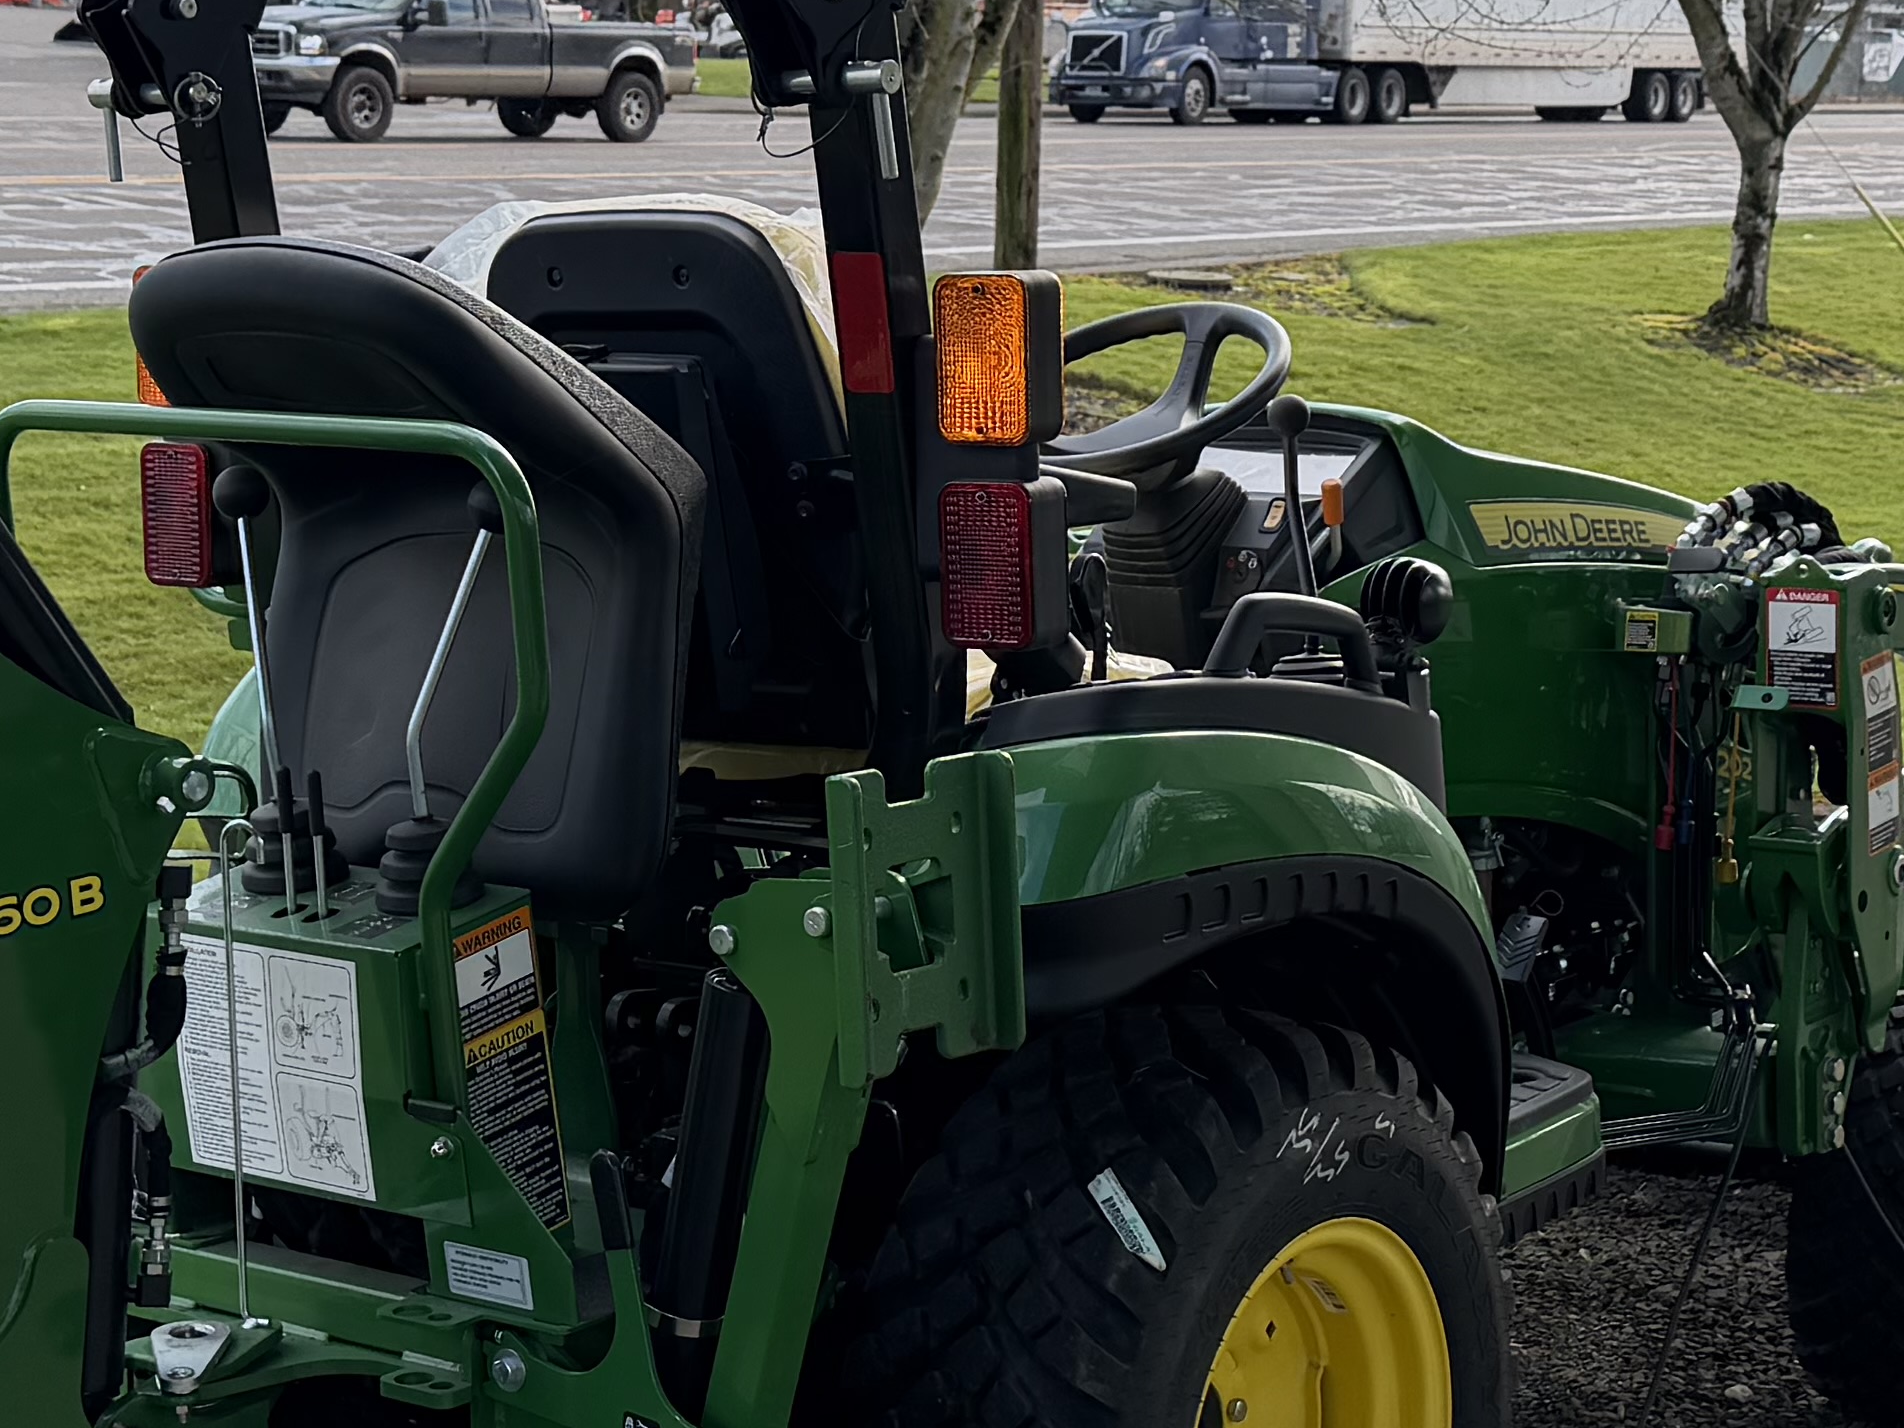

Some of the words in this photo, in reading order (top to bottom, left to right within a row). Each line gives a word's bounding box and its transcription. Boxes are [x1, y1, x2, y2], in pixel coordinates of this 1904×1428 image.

[1500, 514, 1567, 545] JOHN
[1569, 512, 1651, 544] DEERE
[1789, 591, 1829, 602] DANGER
[69, 874, 105, 917] B
[461, 915, 522, 954] WARNING
[478, 1019, 535, 1059] CAUTION
